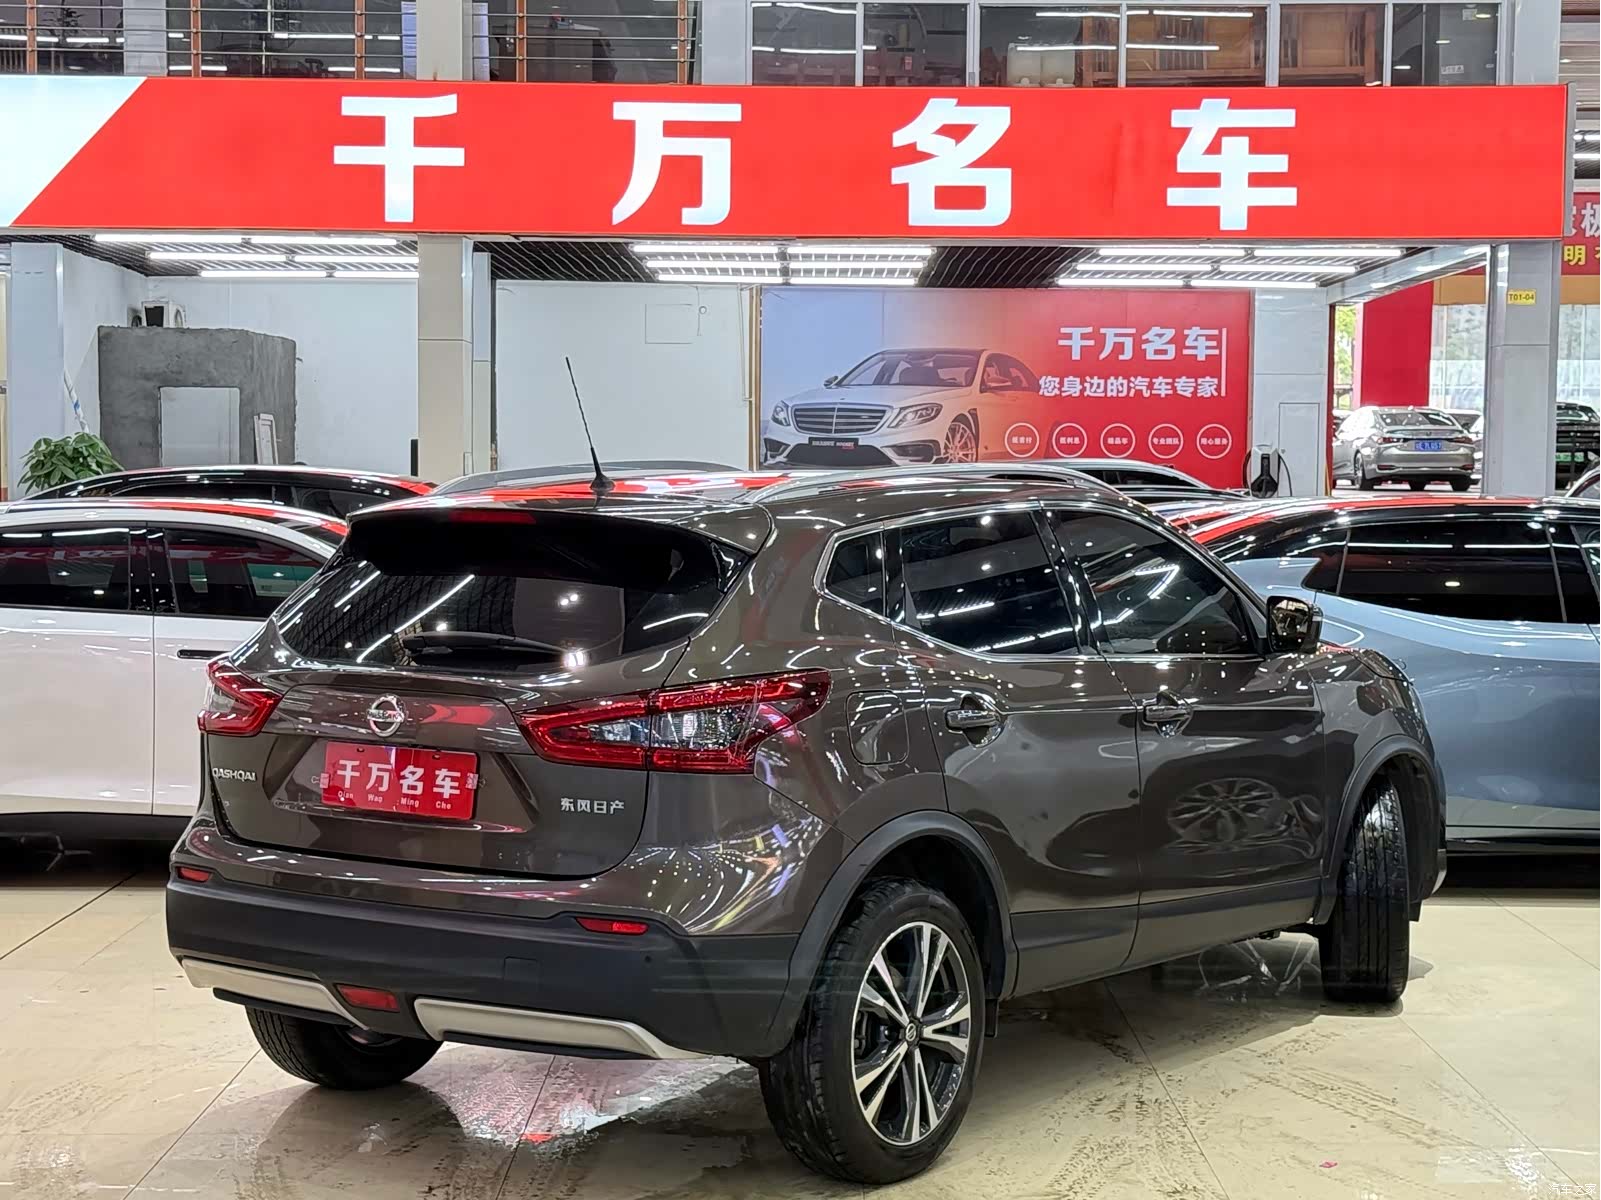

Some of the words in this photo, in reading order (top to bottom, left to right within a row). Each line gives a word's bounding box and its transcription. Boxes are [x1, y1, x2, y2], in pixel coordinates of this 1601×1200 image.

[334, 94, 1297, 230] 千万名车
[1508, 292, 1535, 301] T01-04
[1058, 326, 1219, 361] 千万名车
[1039, 376, 1219, 398] 您身边的汽车专家
[212, 767, 256, 782] QASHQAI
[336, 759, 462, 799] 千万名车
[400, 797, 420, 808] Ming
[435, 800, 452, 810] Che
[560, 796, 626, 815] 东风日产
